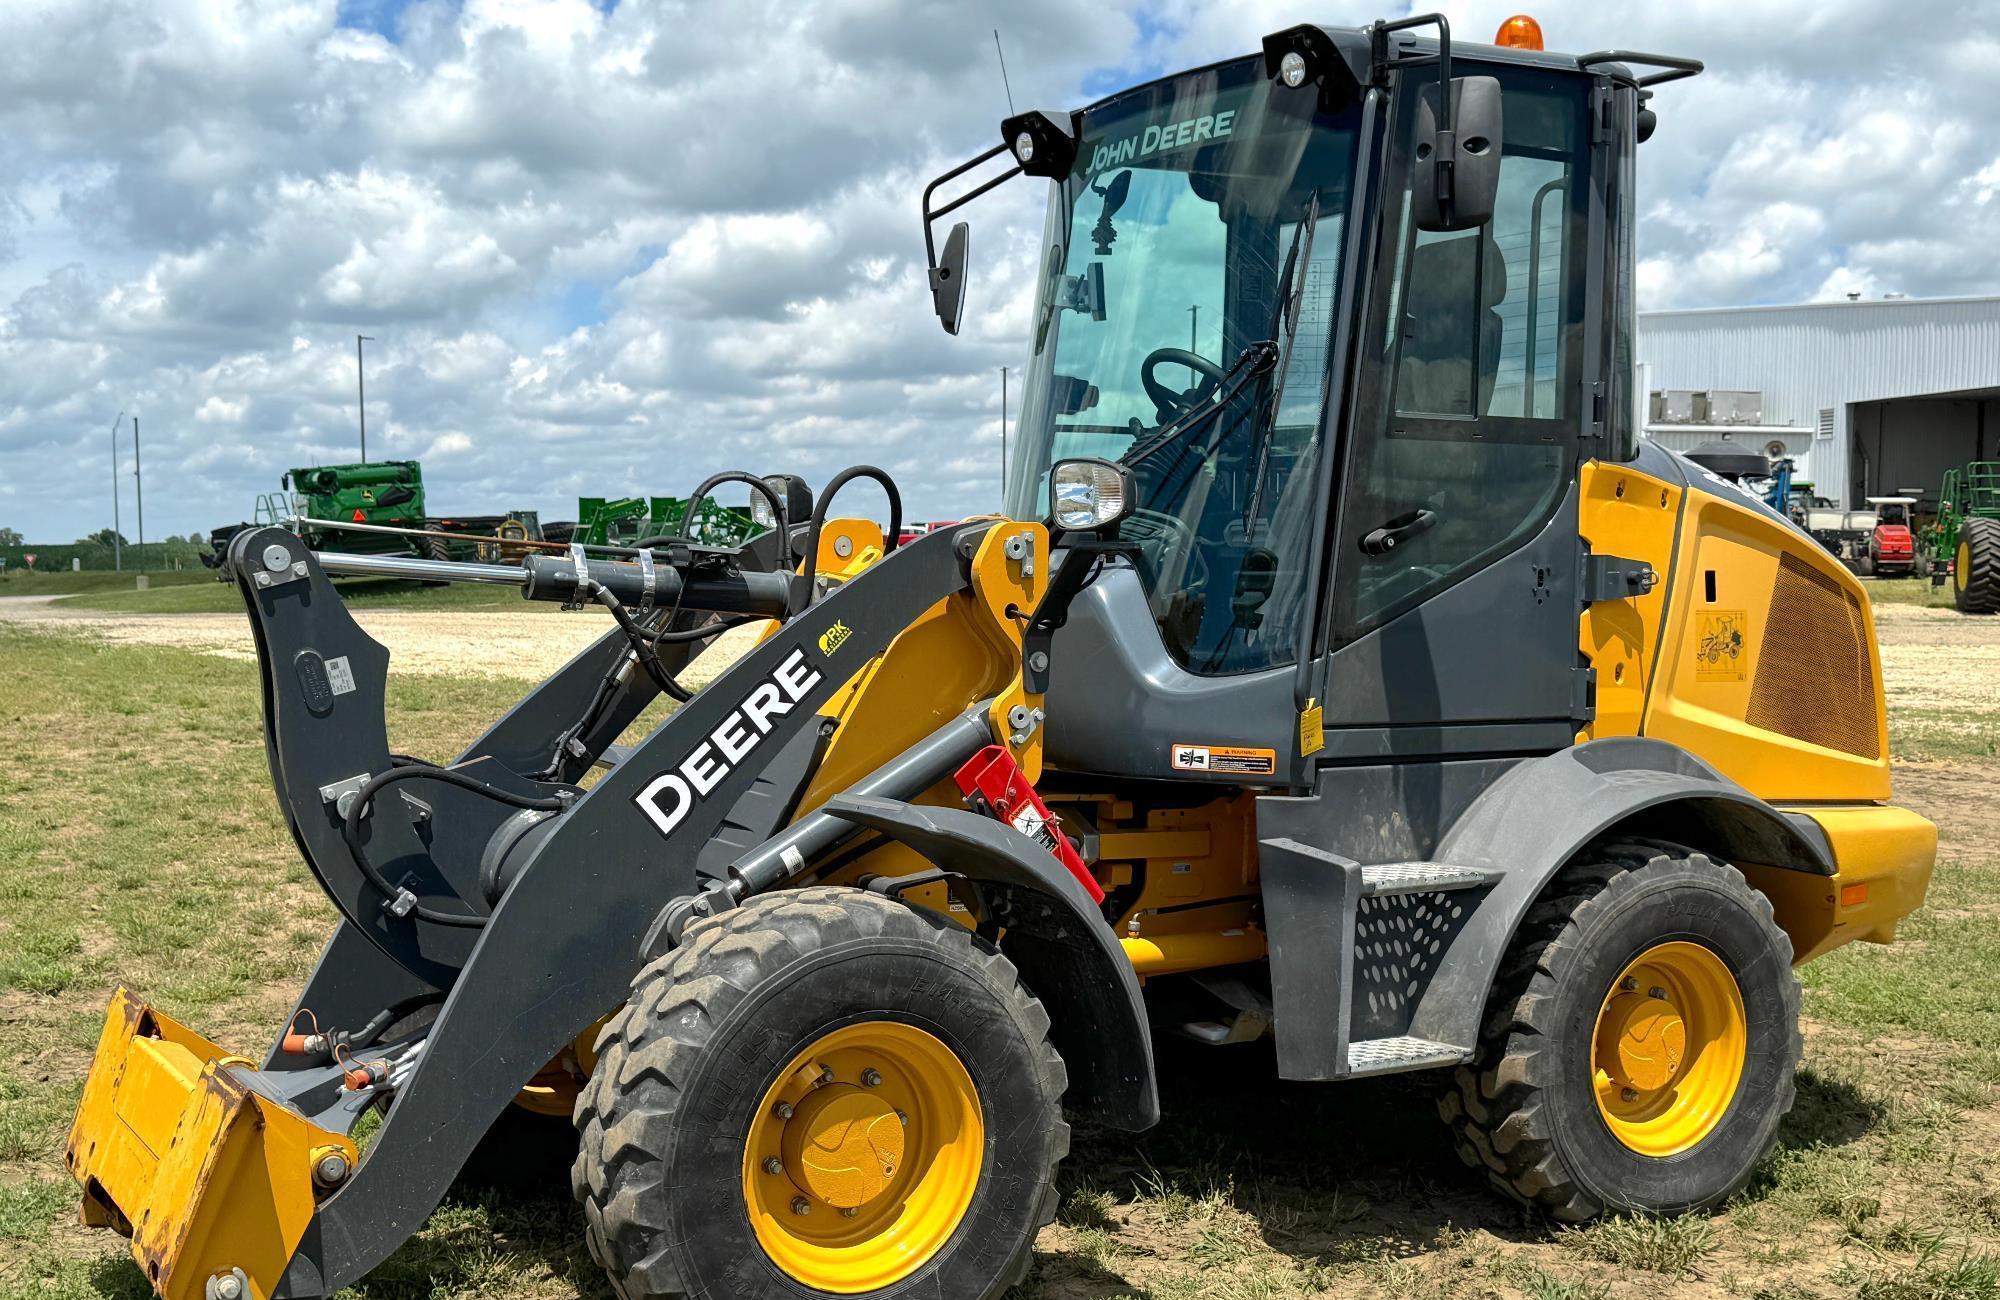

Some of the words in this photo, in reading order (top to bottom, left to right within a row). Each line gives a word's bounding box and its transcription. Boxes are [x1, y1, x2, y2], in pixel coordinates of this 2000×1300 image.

[1085, 135, 1138, 175] JOHN
[1140, 110, 1235, 156] DEERE
[635, 648, 822, 835] DEERE
